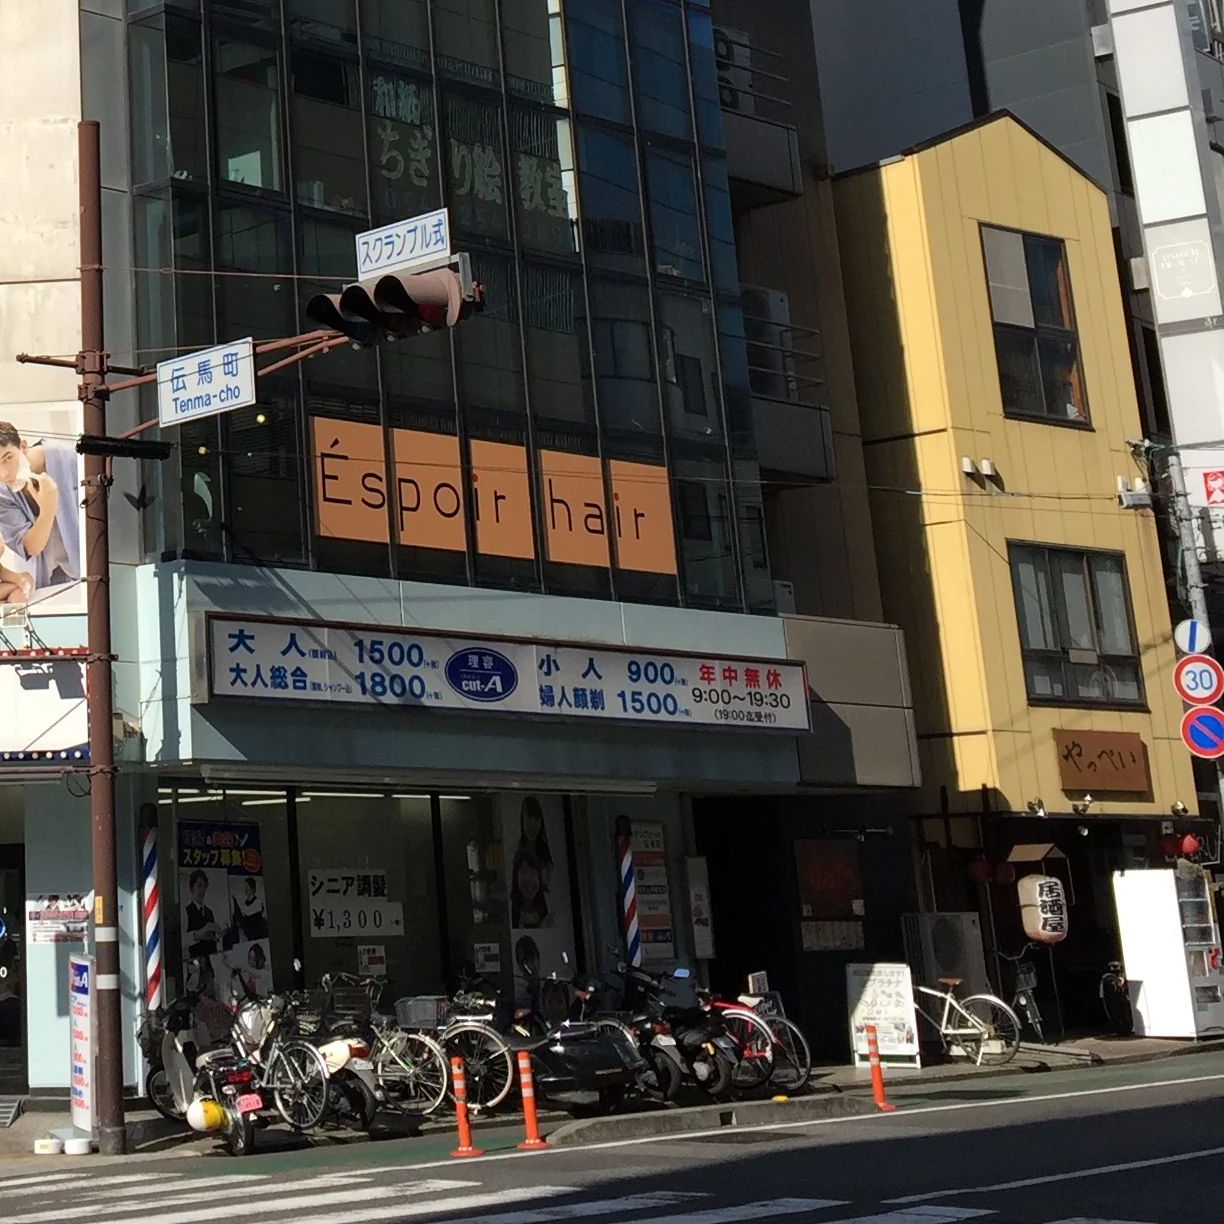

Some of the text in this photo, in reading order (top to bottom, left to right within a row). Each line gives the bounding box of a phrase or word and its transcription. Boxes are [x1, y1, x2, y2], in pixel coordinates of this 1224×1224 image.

[170, 351, 240, 394] 伝馬町
[172, 382, 241, 415] Tenma-cho
[548, 478, 646, 540] hair
[228, 629, 307, 657] 大人
[354, 638, 424, 668] 1500
[467, 654, 494, 669] 理容
[229, 662, 308, 691] 大人総合
[355, 671, 426, 700] 1800
[461, 675, 503, 693] cut-A
[538, 654, 603, 680] 小人
[627, 660, 675, 685] 900
[698, 664, 783, 690] 年中無休
[1185, 668, 1214, 692] 30
[616, 689, 677, 716] 1500
[310, 874, 388, 898] シニア調髪
